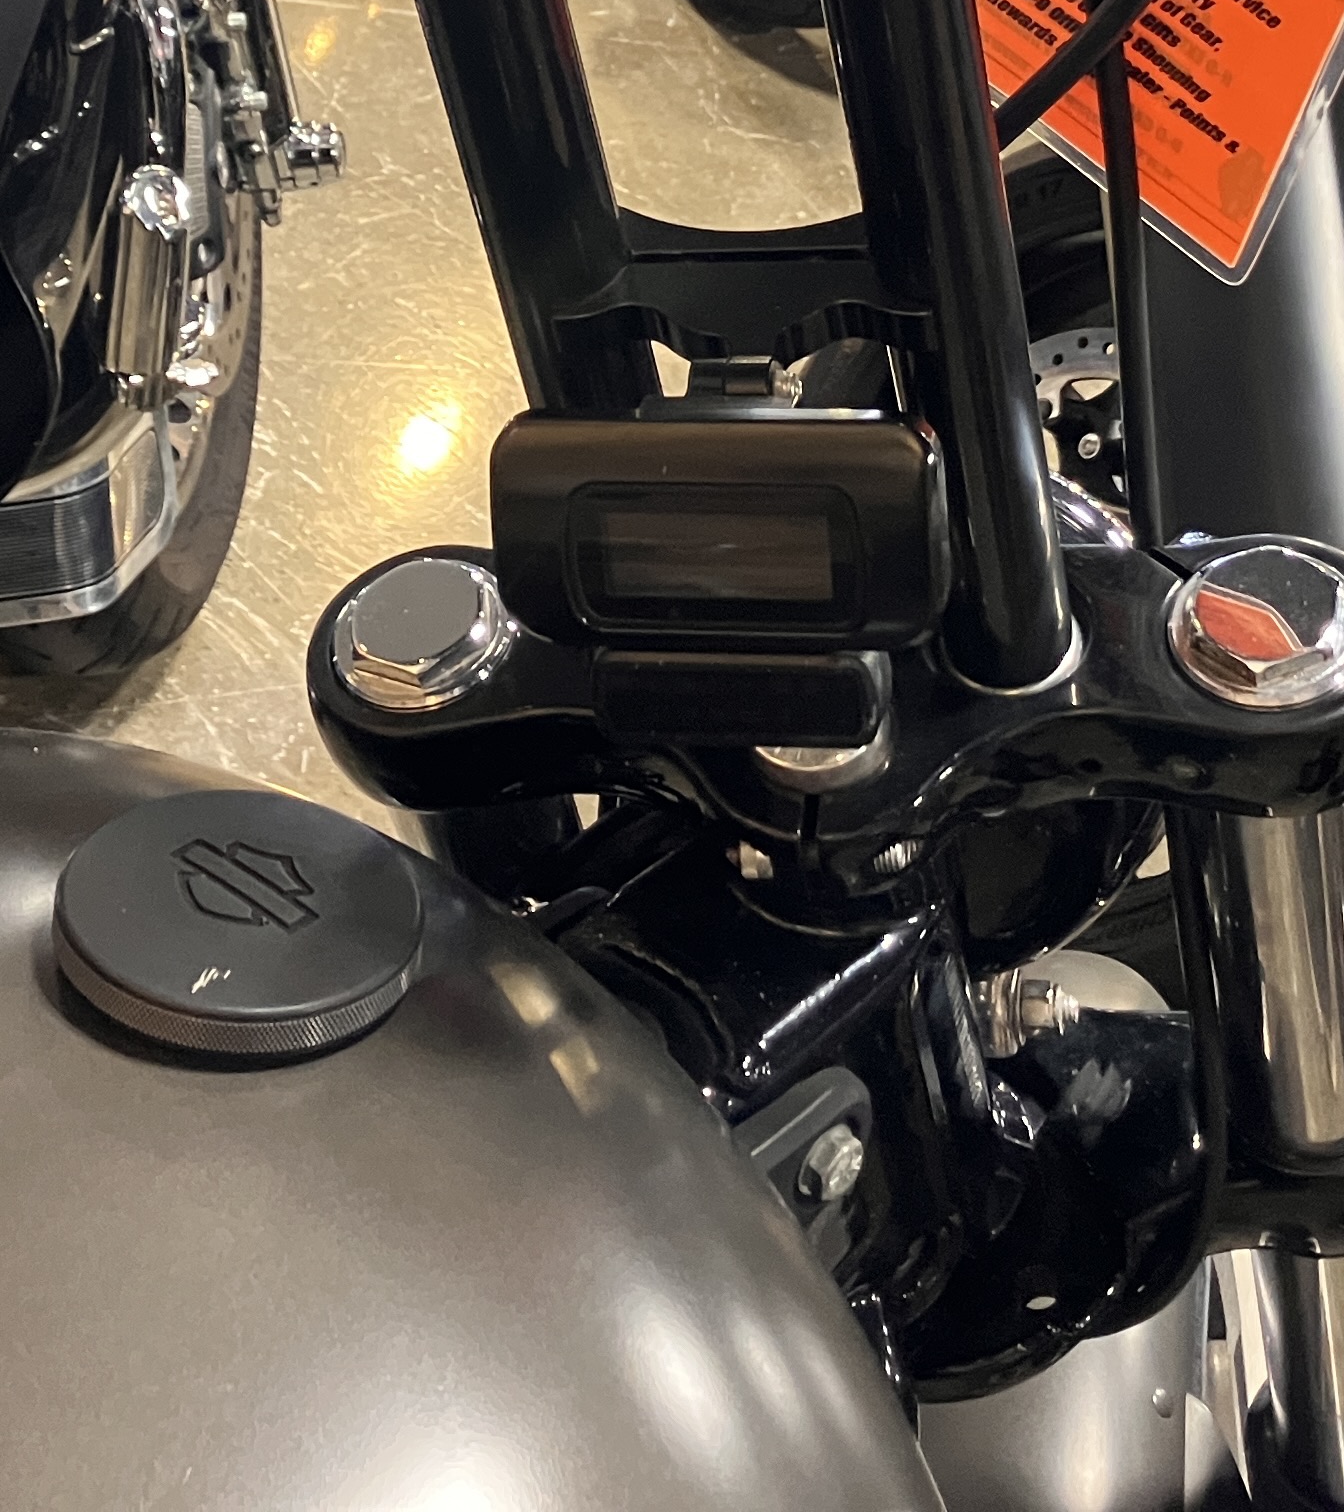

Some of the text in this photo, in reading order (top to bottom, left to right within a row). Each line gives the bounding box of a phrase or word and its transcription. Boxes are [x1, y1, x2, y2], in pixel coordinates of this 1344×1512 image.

[1139, 13, 1182, 48] Gifts
[1159, 0, 1186, 18] of
[1179, 12, 1224, 52] Gear,
[1131, 37, 1212, 103] Shopping
[1169, 98, 1227, 143] Points
[1224, 140, 1241, 154] &
